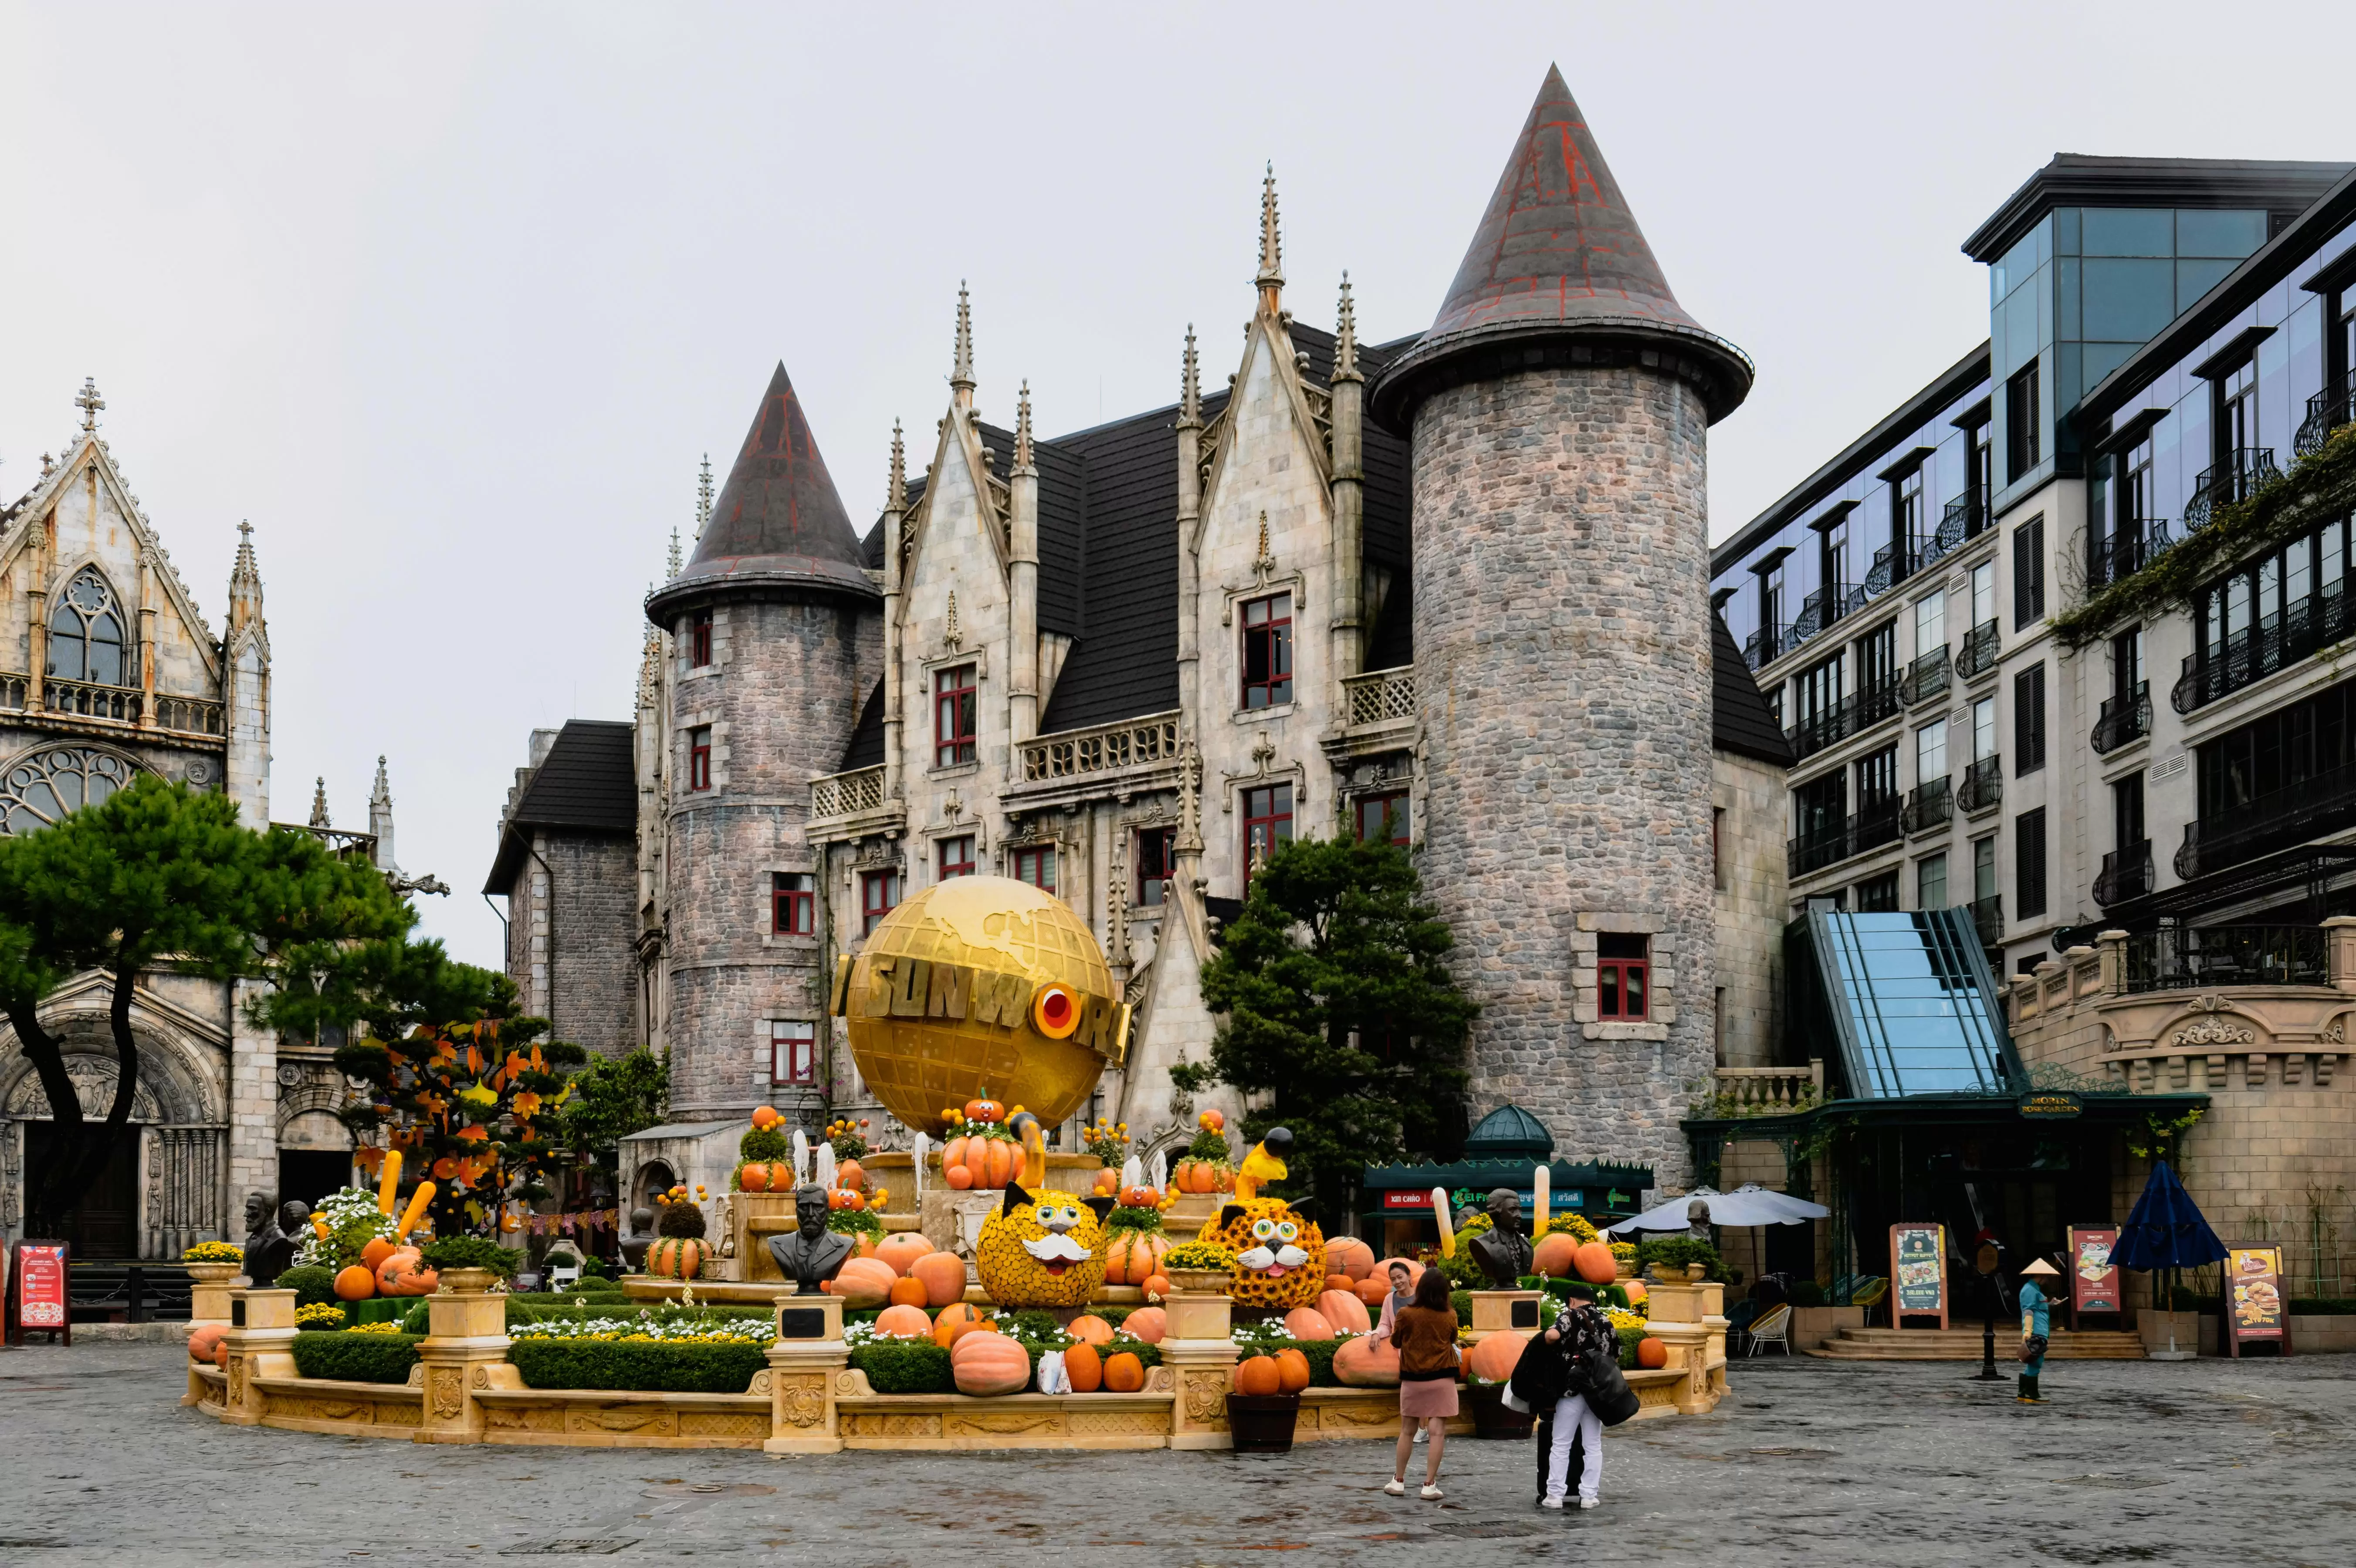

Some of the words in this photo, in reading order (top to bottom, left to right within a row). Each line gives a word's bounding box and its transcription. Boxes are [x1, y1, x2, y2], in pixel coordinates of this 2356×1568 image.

[864, 953, 975, 1019] SUN
[1403, 1194, 1420, 1202] CHÀO
[2080, 1243, 2112, 1251] ROSA
